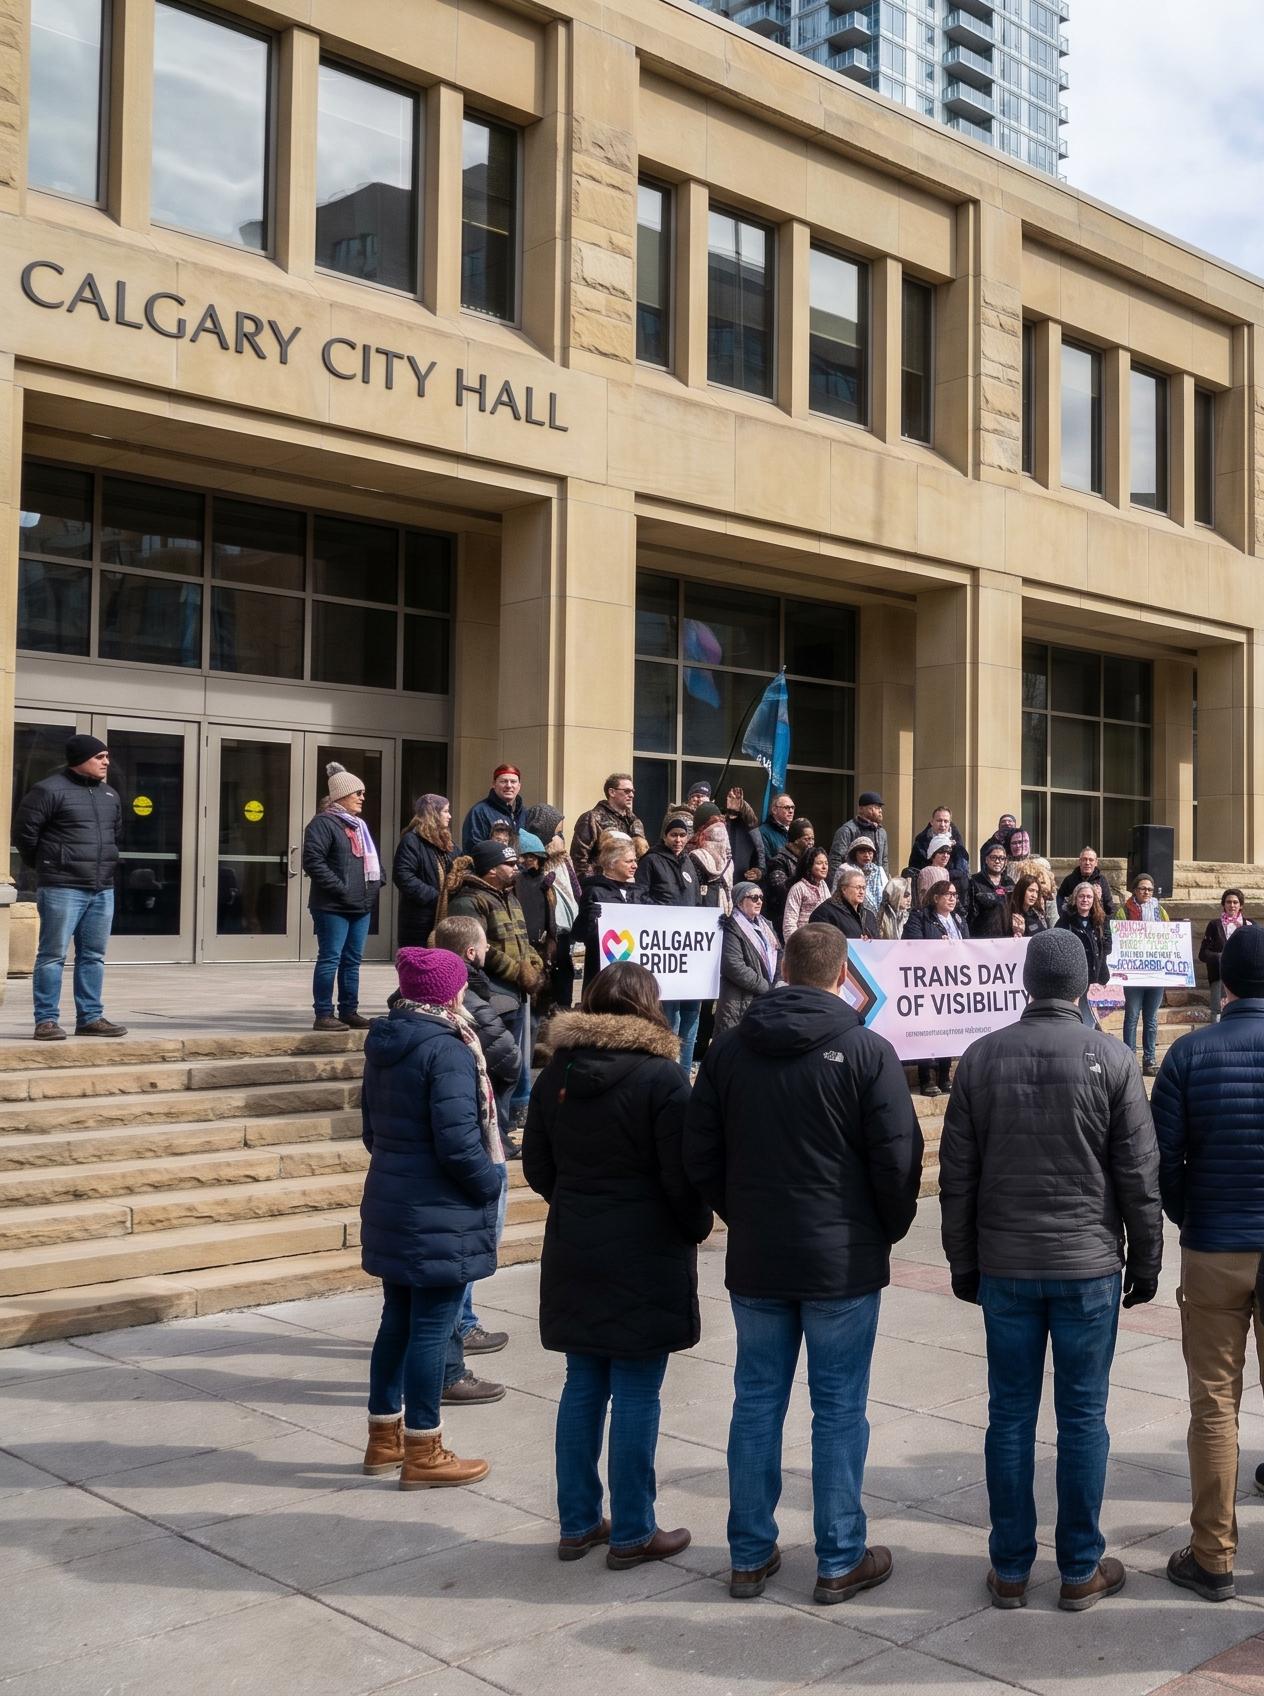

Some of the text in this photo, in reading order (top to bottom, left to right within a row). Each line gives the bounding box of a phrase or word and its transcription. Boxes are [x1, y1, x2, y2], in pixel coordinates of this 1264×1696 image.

[20, 260, 569, 433] CALGARY CITY HALL
[639, 929, 716, 952] CALGARY
[639, 953, 688, 974] PRIDE
[899, 962, 1017, 988] TRANS DAY
[896, 989, 1030, 1017] OF VISIBILITY
